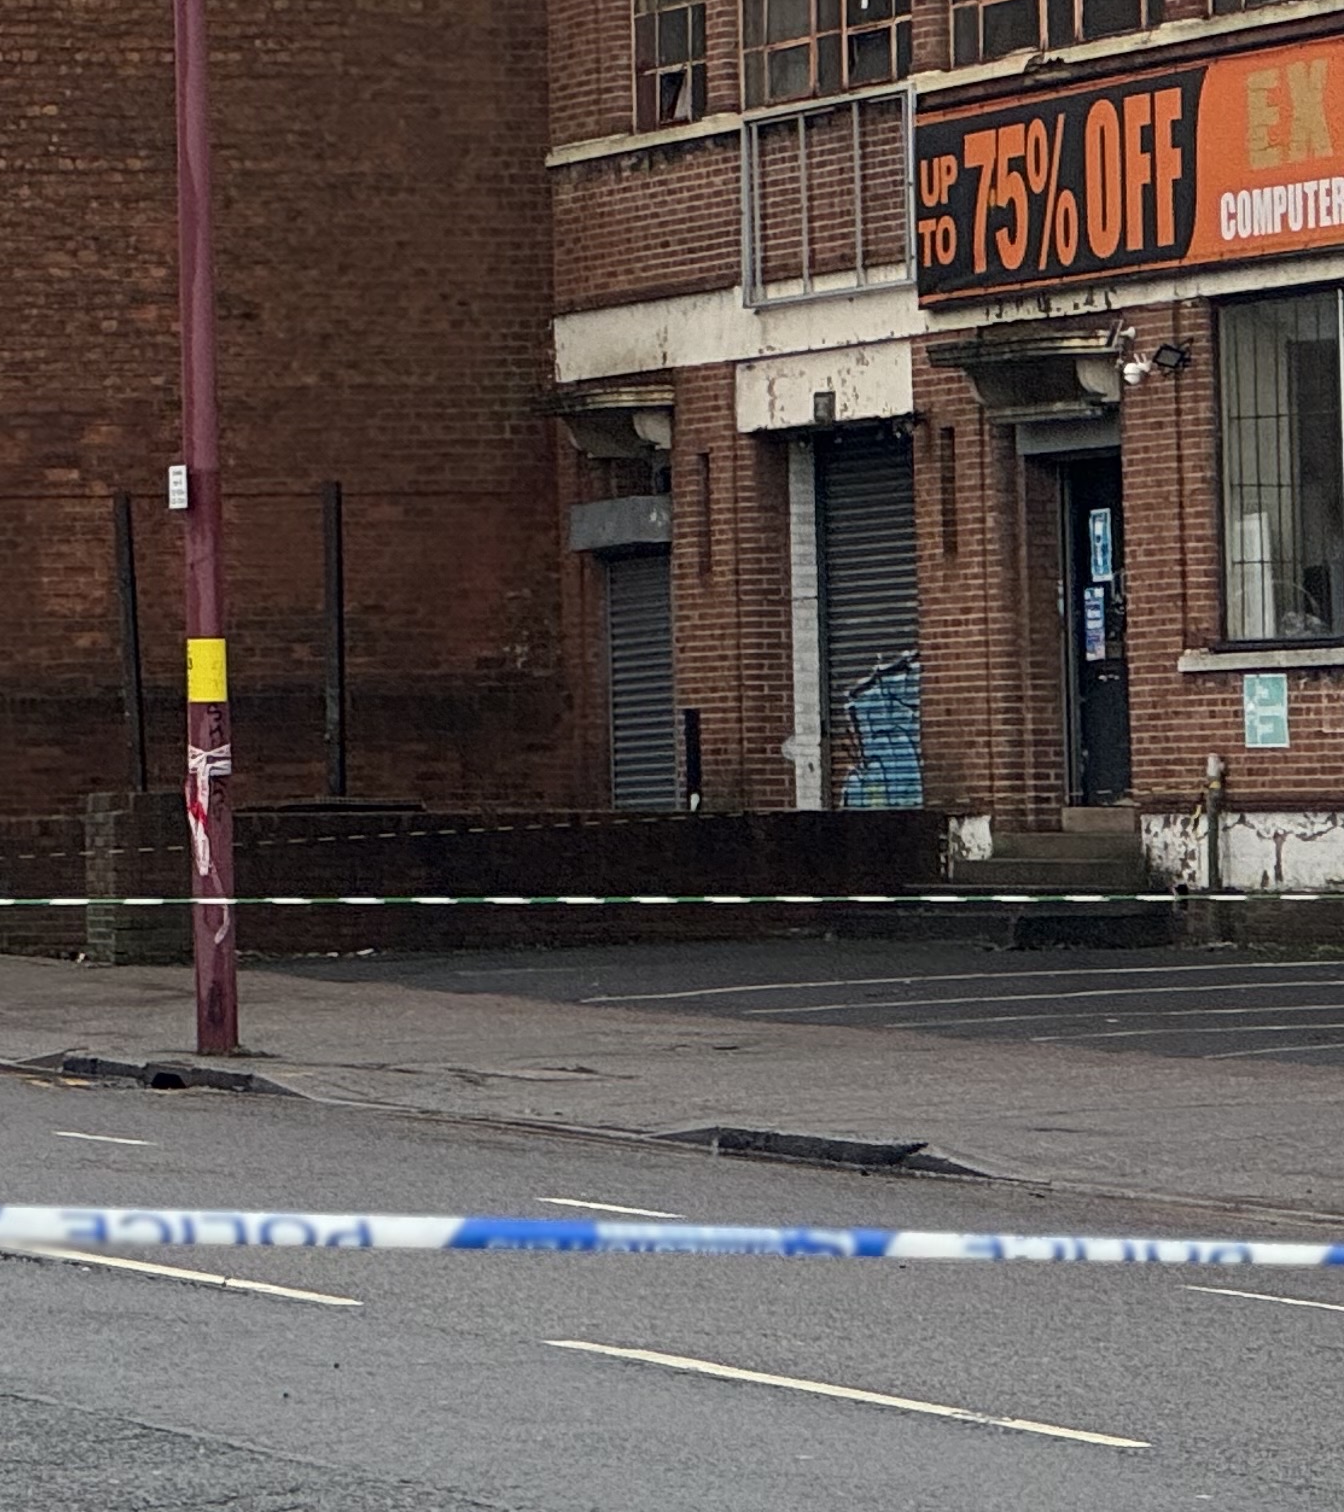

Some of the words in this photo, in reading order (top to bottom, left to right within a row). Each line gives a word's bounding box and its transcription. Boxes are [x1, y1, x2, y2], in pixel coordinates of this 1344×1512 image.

[919, 153, 958, 208] UP
[963, 113, 1079, 275] 75%
[1084, 87, 1183, 259] OFF
[918, 215, 957, 268] TO
